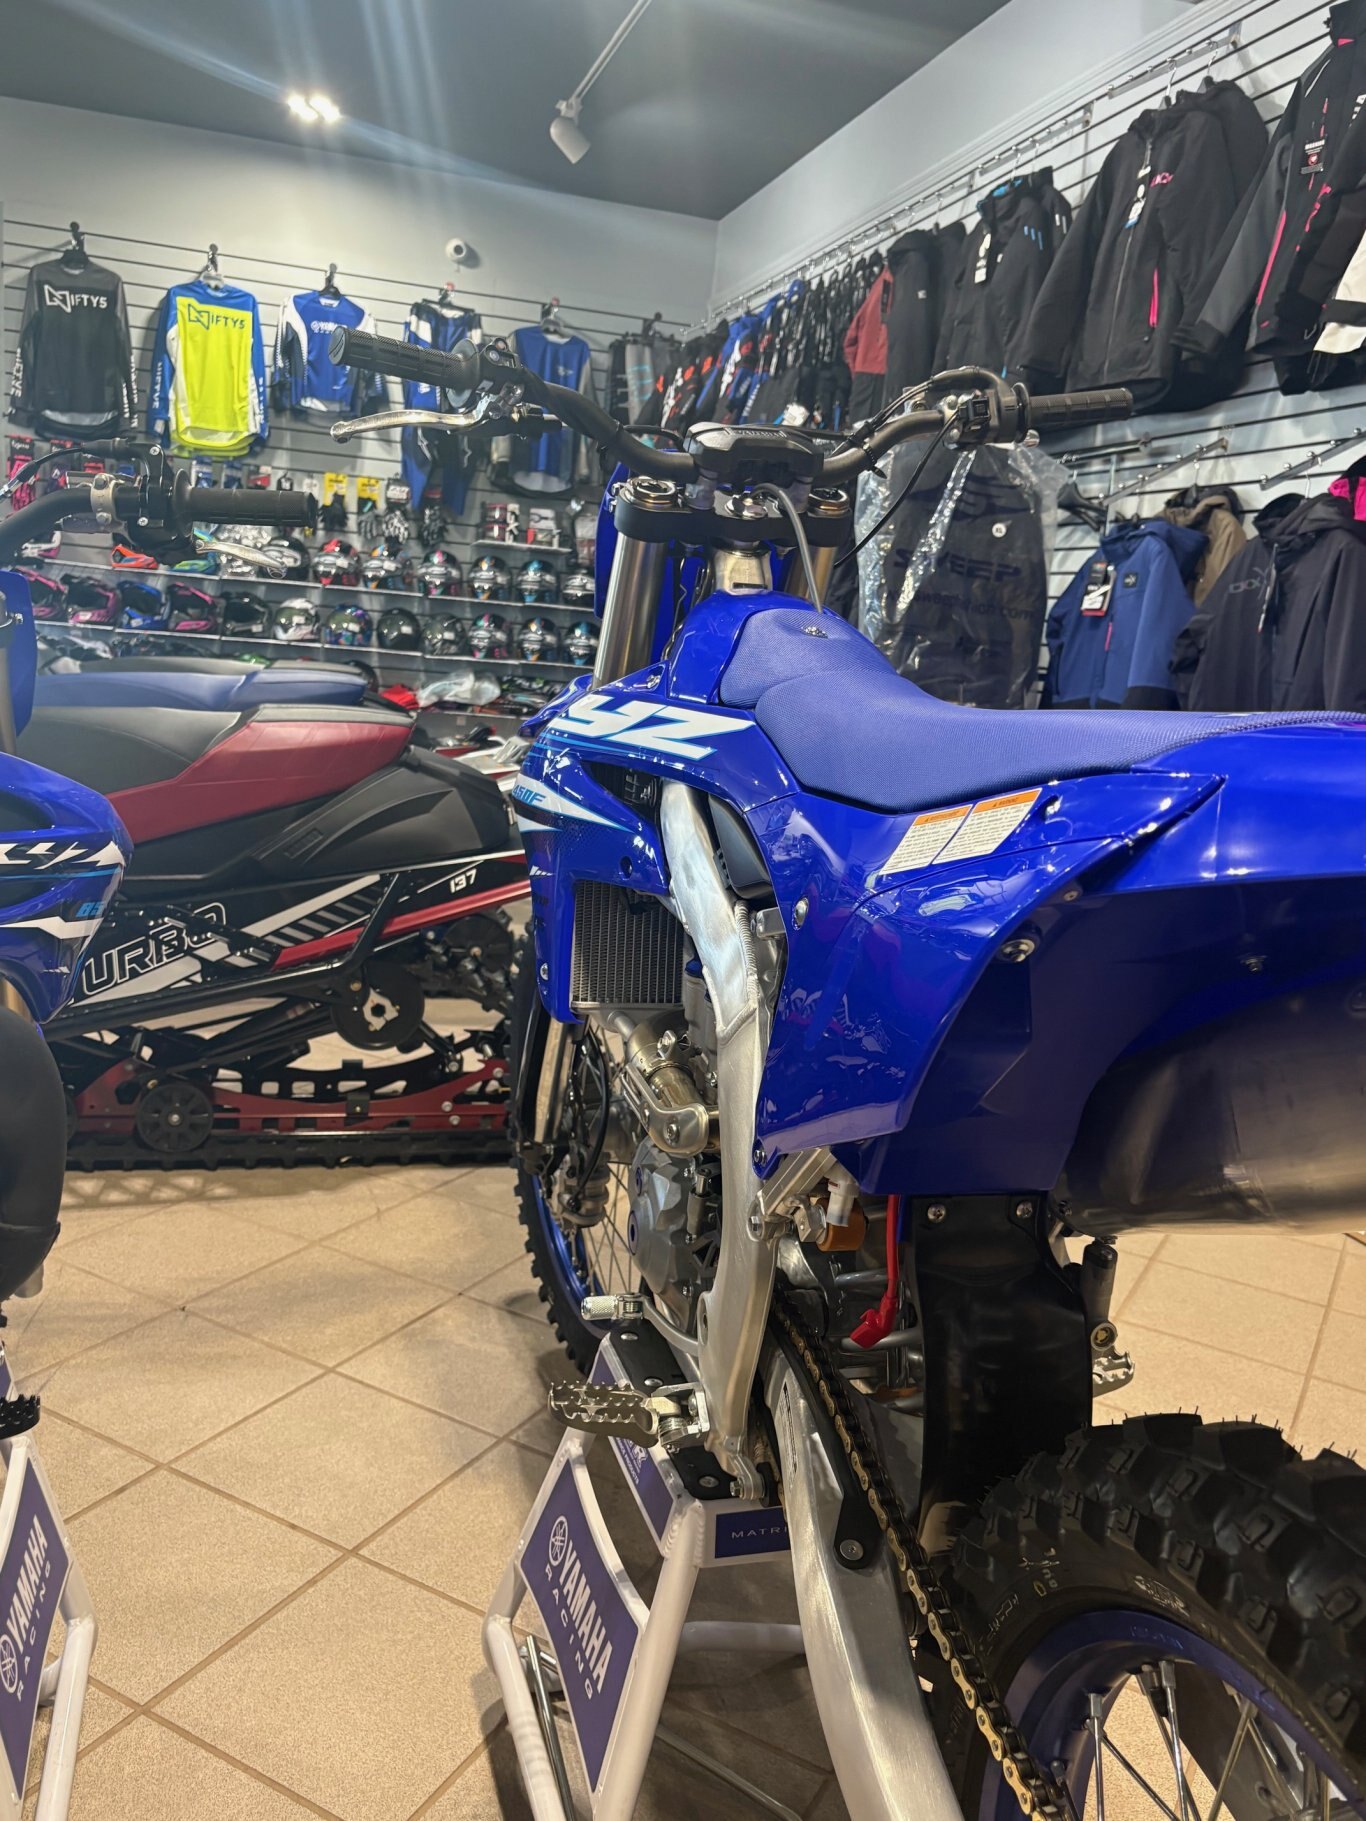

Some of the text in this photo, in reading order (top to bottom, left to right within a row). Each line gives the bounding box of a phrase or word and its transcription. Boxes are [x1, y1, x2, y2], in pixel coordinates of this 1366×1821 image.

[547, 694, 756, 761] YZ
[512, 784, 547, 806] 450F
[76, 902, 105, 917] 85
[450, 869, 478, 894] 137
[82, 902, 227, 996] URBO
[731, 1526, 787, 1540] MATRI
[6, 1514, 49, 1654] YAMAHA
[559, 1539, 613, 1694] YAMAHA
[17, 1560, 51, 1702] RACING
[545, 1563, 594, 1700] RACING
